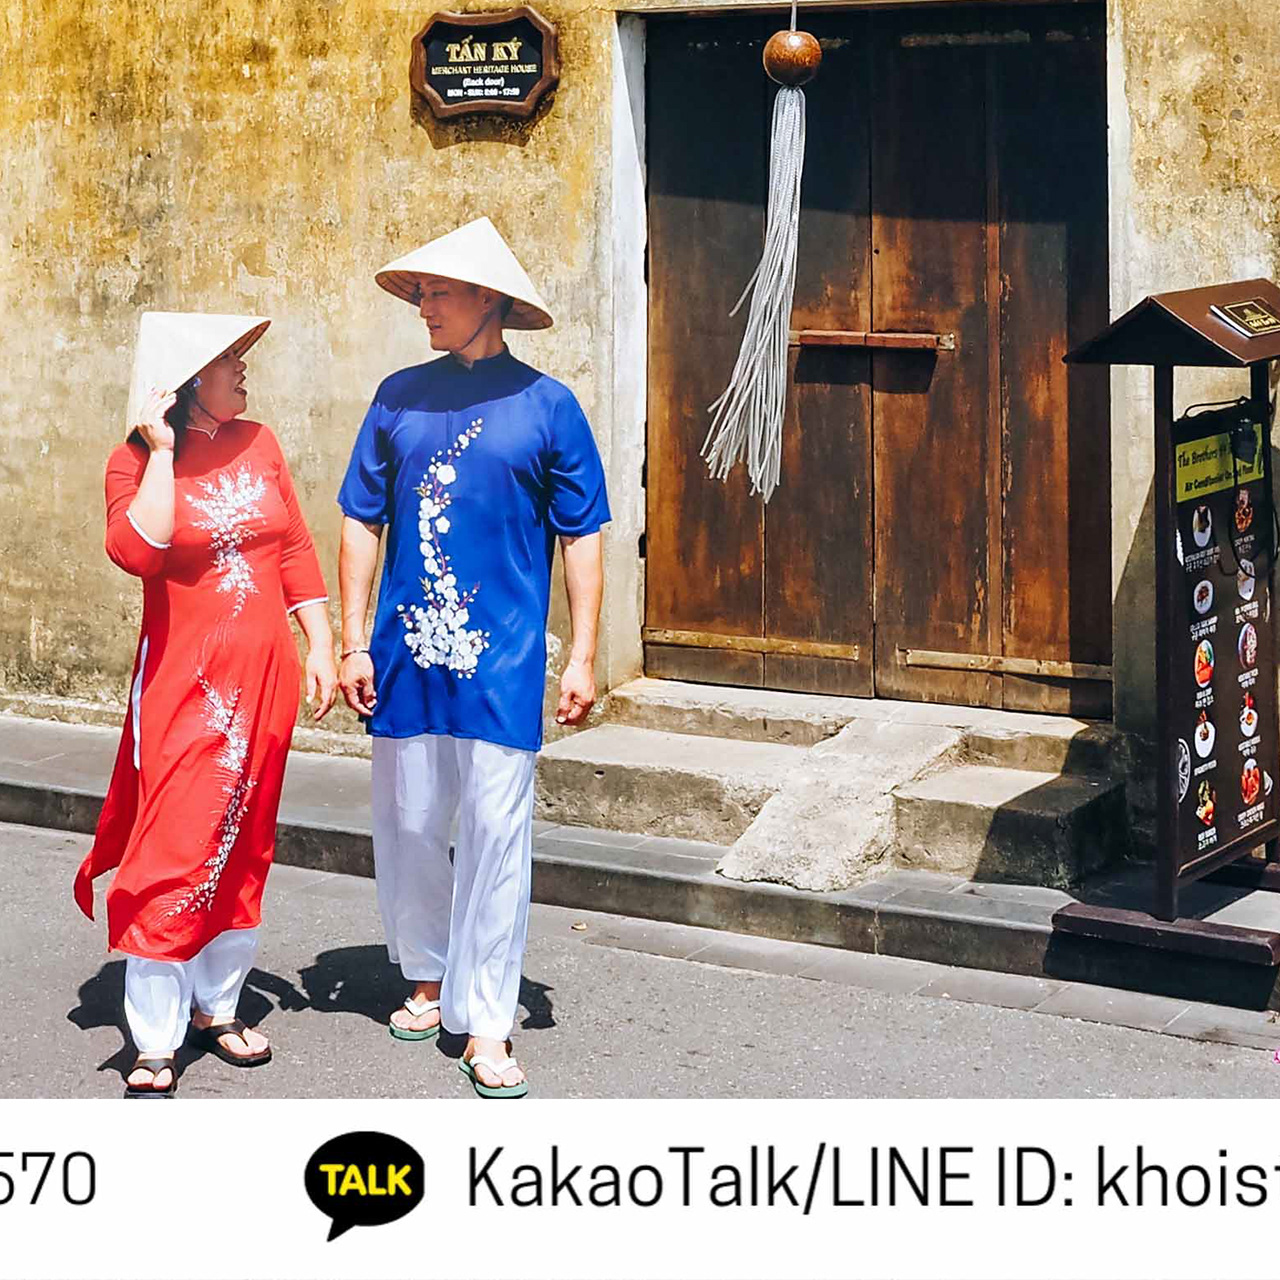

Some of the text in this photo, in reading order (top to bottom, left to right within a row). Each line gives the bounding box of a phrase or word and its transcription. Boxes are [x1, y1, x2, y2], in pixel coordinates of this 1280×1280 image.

[445, 34, 522, 62] TẤN KÝ
[431, 64, 538, 75] MERCHANT HERITAGE HOUSE
[462, 77, 505, 87] (Back door)
[1178, 451, 1190, 468] The
